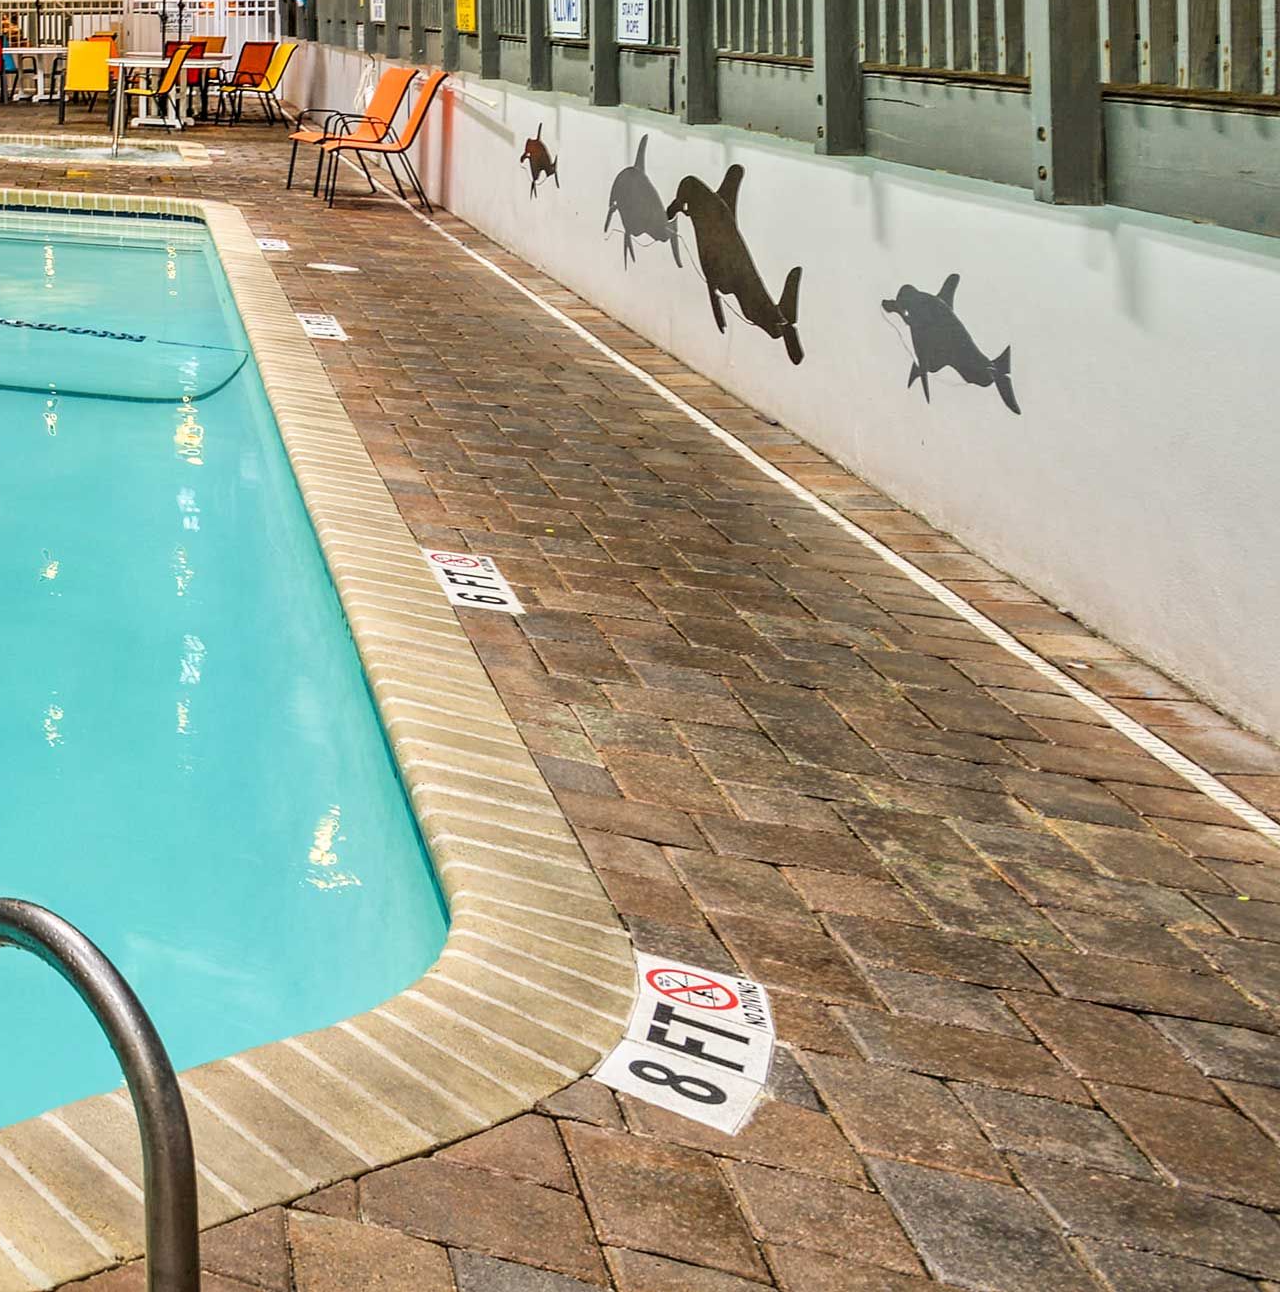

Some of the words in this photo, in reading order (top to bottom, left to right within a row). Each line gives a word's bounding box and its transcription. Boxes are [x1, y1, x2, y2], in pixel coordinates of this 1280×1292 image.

[622, 2, 634, 16] STAY
[634, 2, 645, 16] OFF
[442, 568, 501, 591] FT
[456, 592, 509, 605] 6
[736, 981, 765, 1014] DIVING
[744, 1012, 768, 1029] NO
[646, 1001, 751, 1073] FT
[628, 1059, 728, 1106] 8
